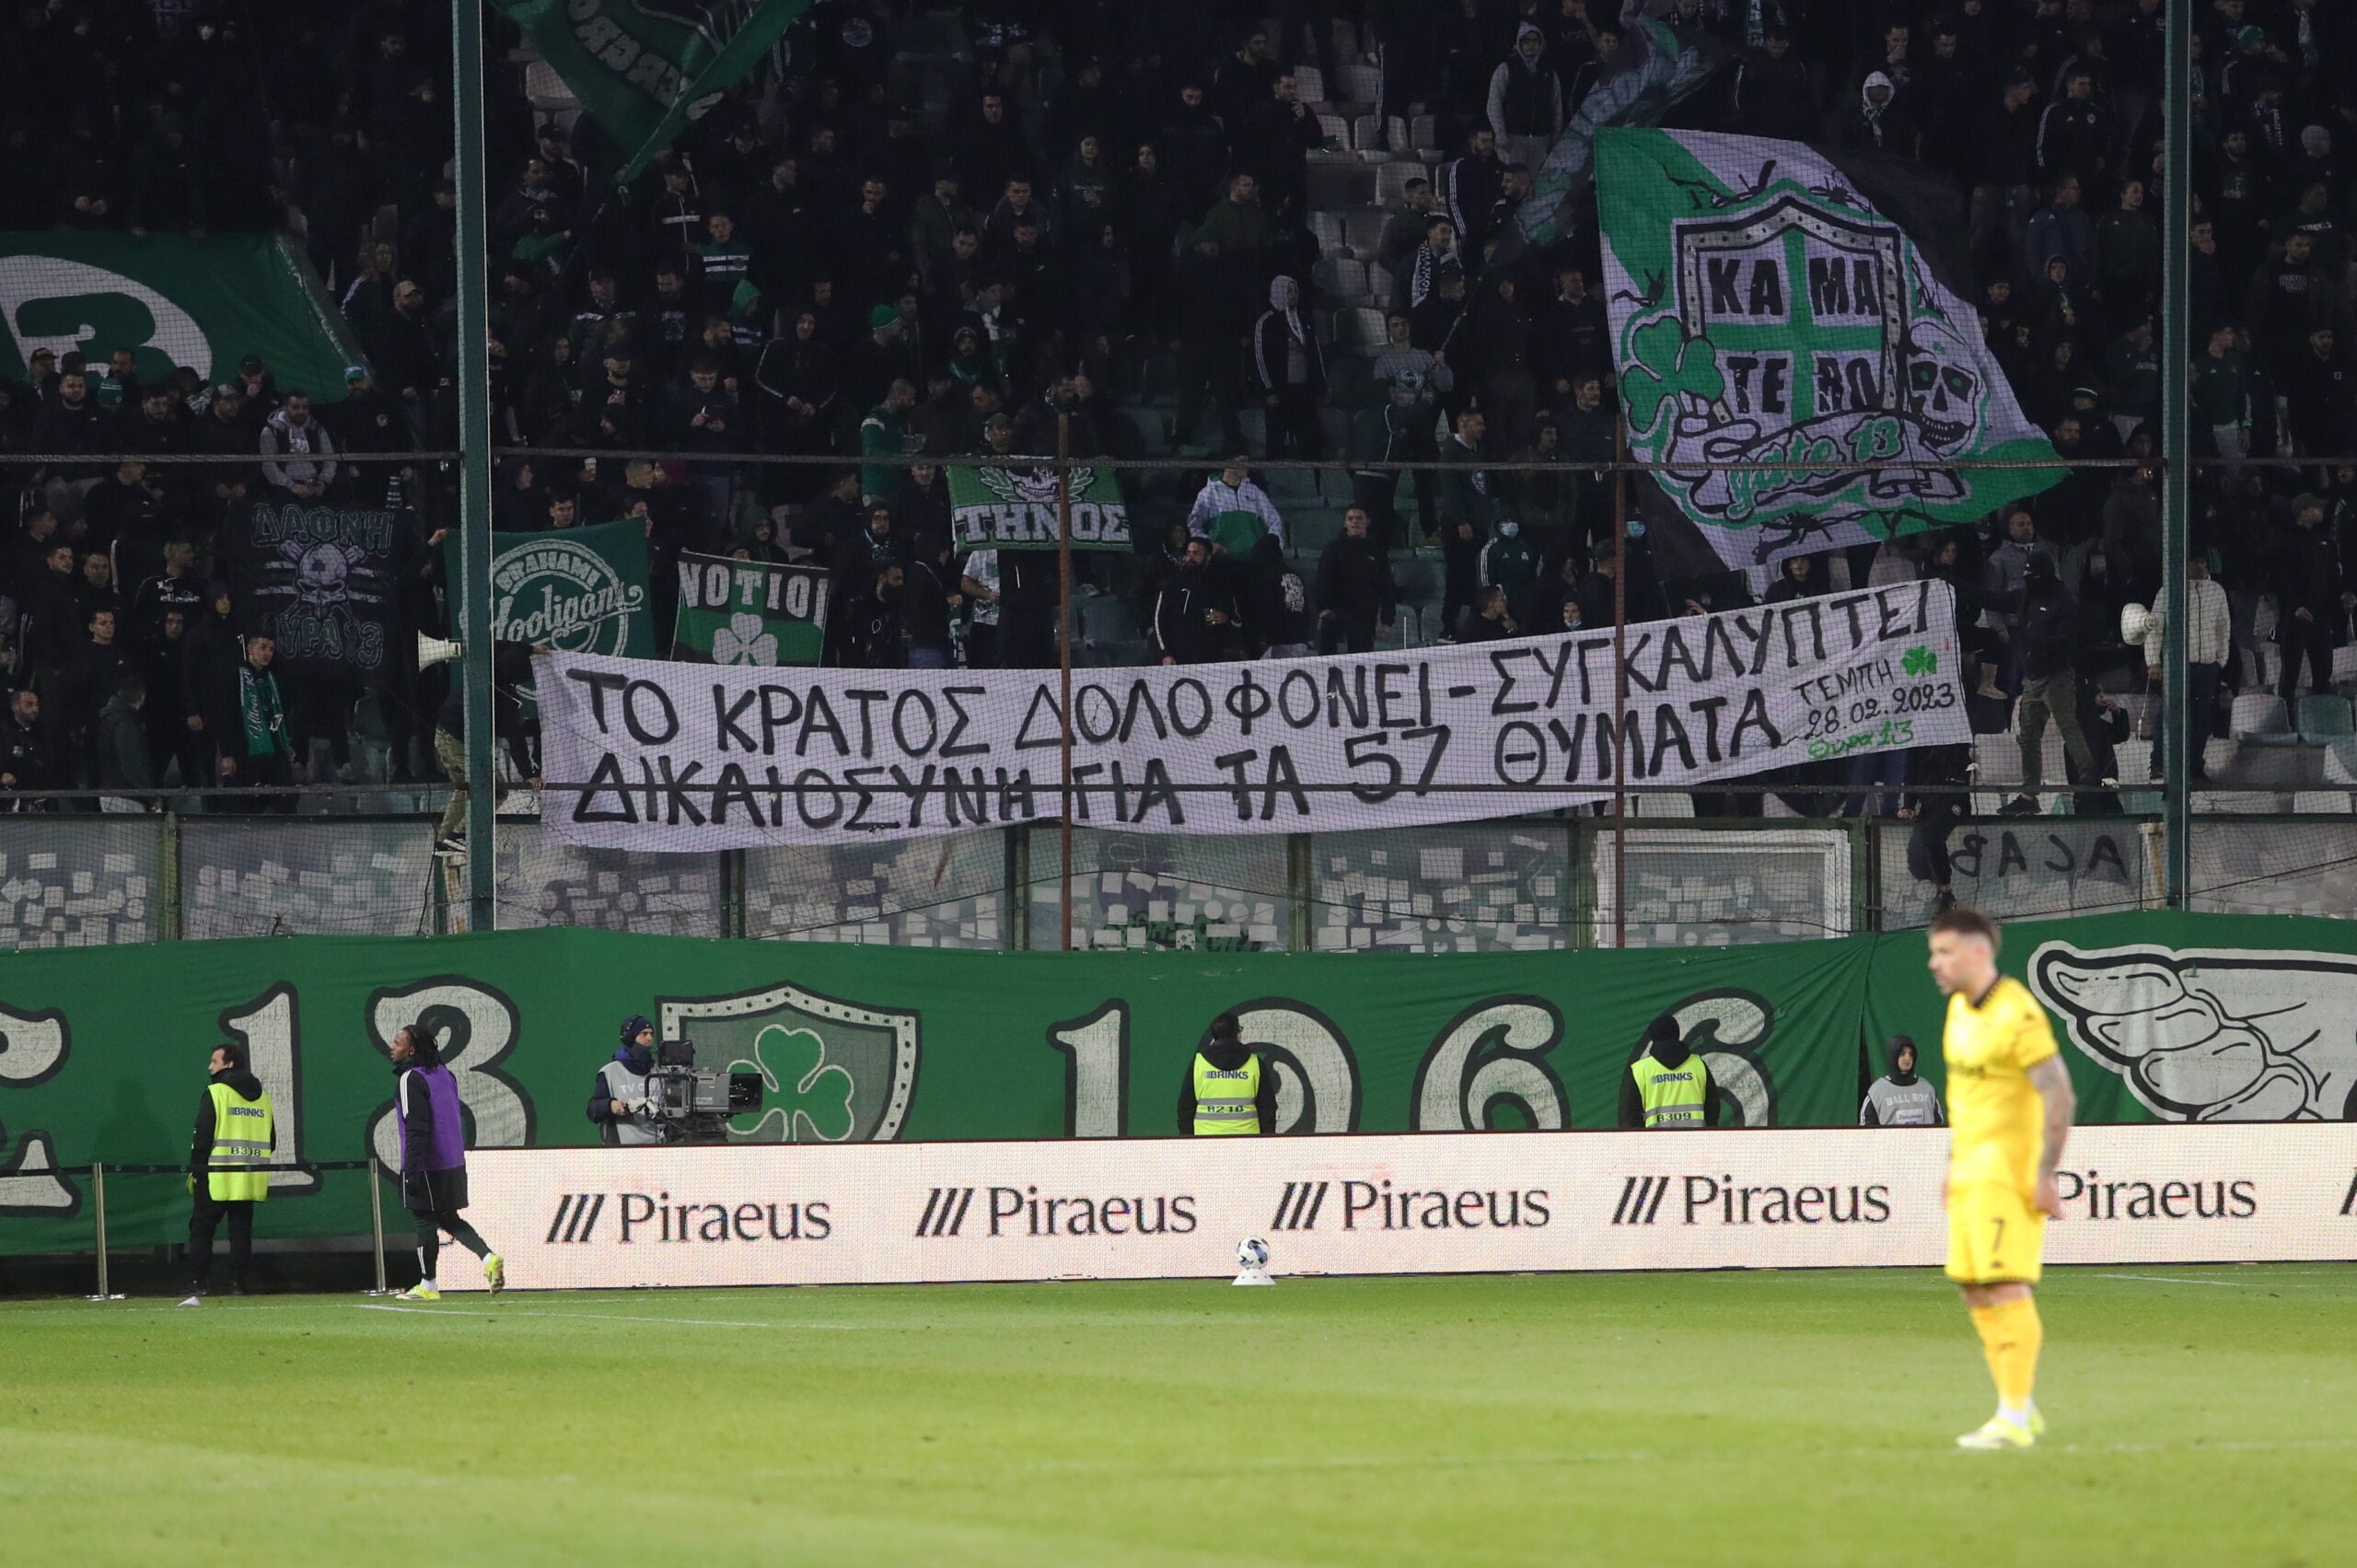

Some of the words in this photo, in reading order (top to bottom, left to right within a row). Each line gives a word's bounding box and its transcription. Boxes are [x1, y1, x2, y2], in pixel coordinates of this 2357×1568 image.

[1848, 413, 1902, 461] 13
[251, 503, 394, 557] ΔΑΦΝΗ
[954, 502, 1132, 543] ΤΗΝΟΣ
[566, 668, 679, 746] ΤΟ
[712, 682, 990, 759] ΚΡΑΤΟΣ
[1015, 661, 1433, 750] ΔΟΛΟΦΟΝΕΙ
[1490, 579, 1931, 715] ΣΥΓΚΑΛΥΠΤΕΙ
[1793, 658, 1895, 706] ΤΕΜΠΗ
[572, 751, 1038, 829] ΔΙΚΑΙΟΣΥΝΗ
[1072, 757, 1185, 825] ΓΙΑ
[1214, 744, 1311, 821] ΤΑ
[1344, 725, 1452, 804] 57
[1494, 687, 1783, 785] ΘΥΜΑΤΑ
[1209, 1070, 1249, 1080] BRINKS
[1656, 1072, 1693, 1084] BRINKS
[232, 1107, 265, 1119] BRINKS
[1885, 1094, 1910, 1107] BALL
[619, 1191, 831, 1243] Piraeus
[986, 1185, 1198, 1237] Piraeus
[1341, 1179, 1551, 1231] Piraeus
[1680, 1172, 1892, 1226] Piraeus
[2049, 1169, 2258, 1221] Piraeus
[1991, 1216, 2006, 1253] 7
